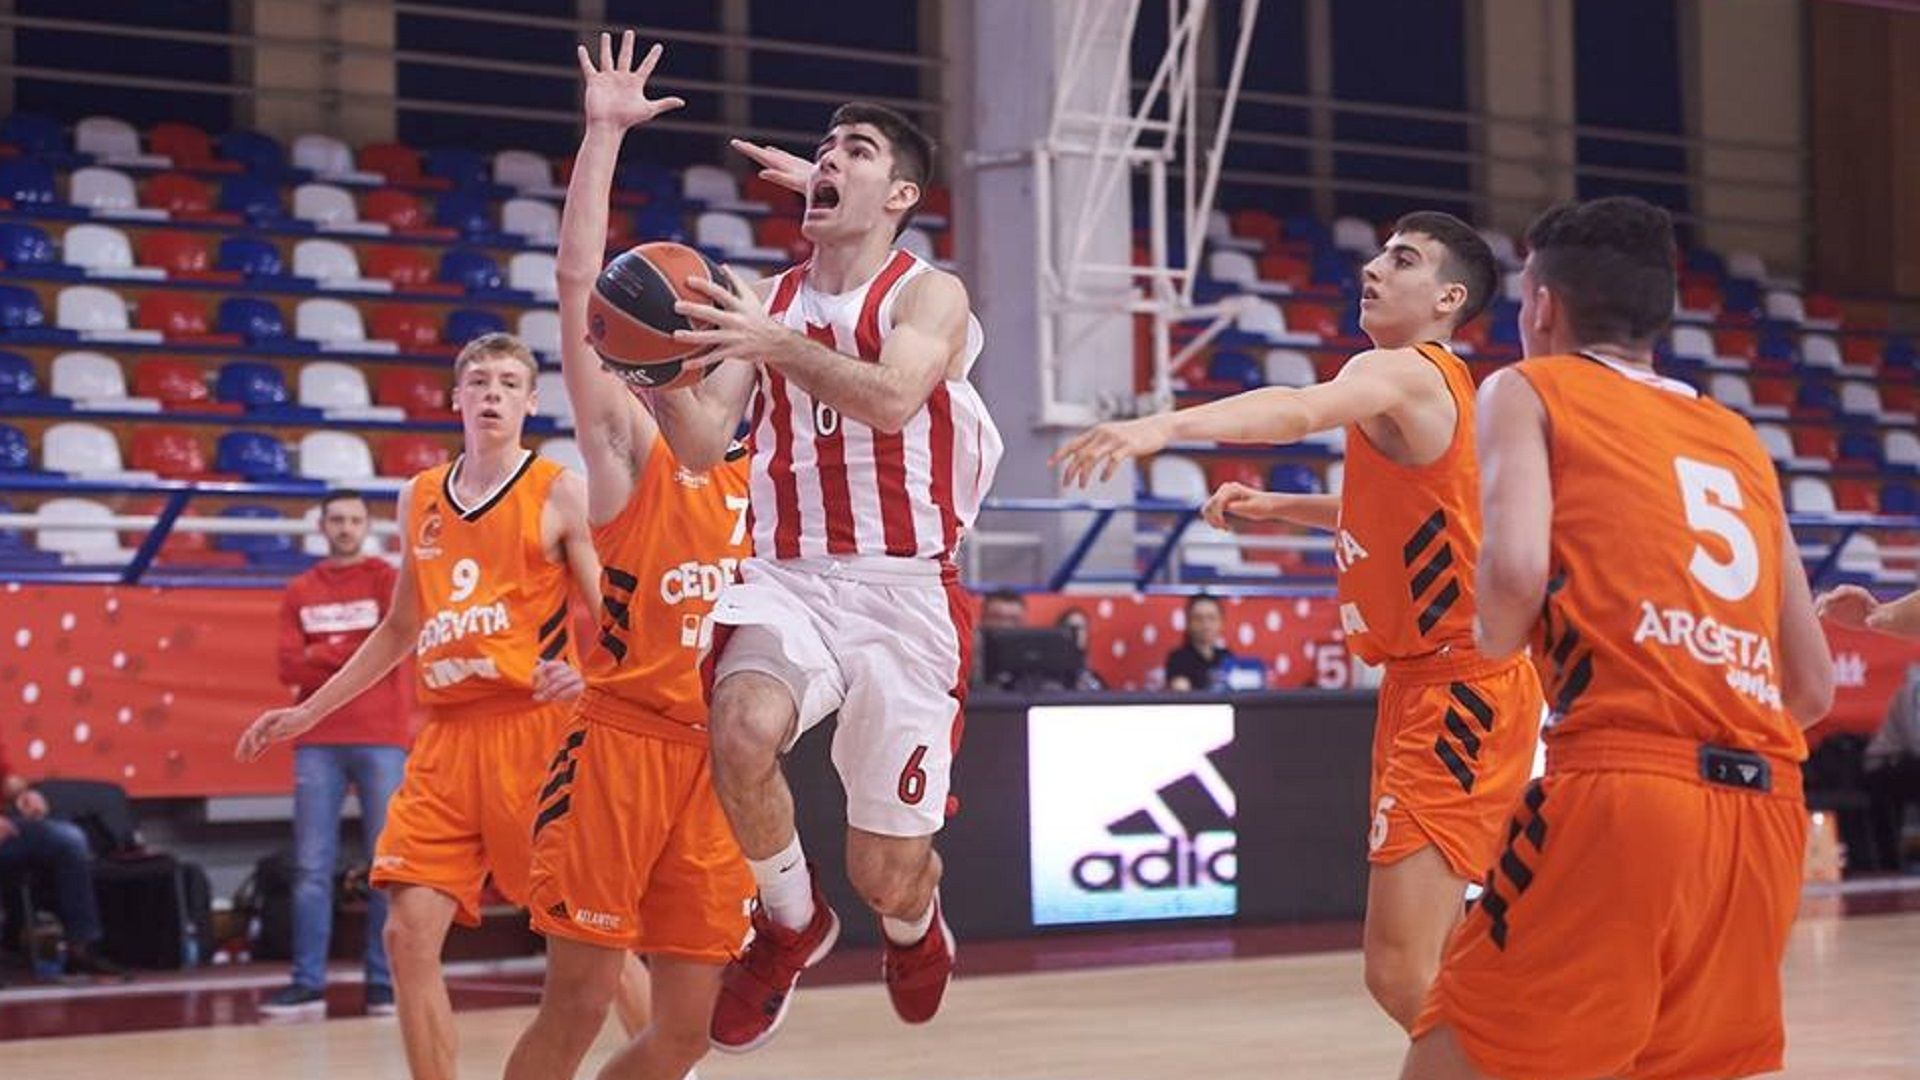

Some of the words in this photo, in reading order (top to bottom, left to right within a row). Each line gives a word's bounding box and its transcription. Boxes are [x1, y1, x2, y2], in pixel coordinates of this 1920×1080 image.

[725, 495, 749, 546] 7
[1673, 456, 1759, 602] 5
[450, 558, 479, 603] 9
[1632, 600, 1774, 676] ARGETA
[898, 744, 928, 806] 6
